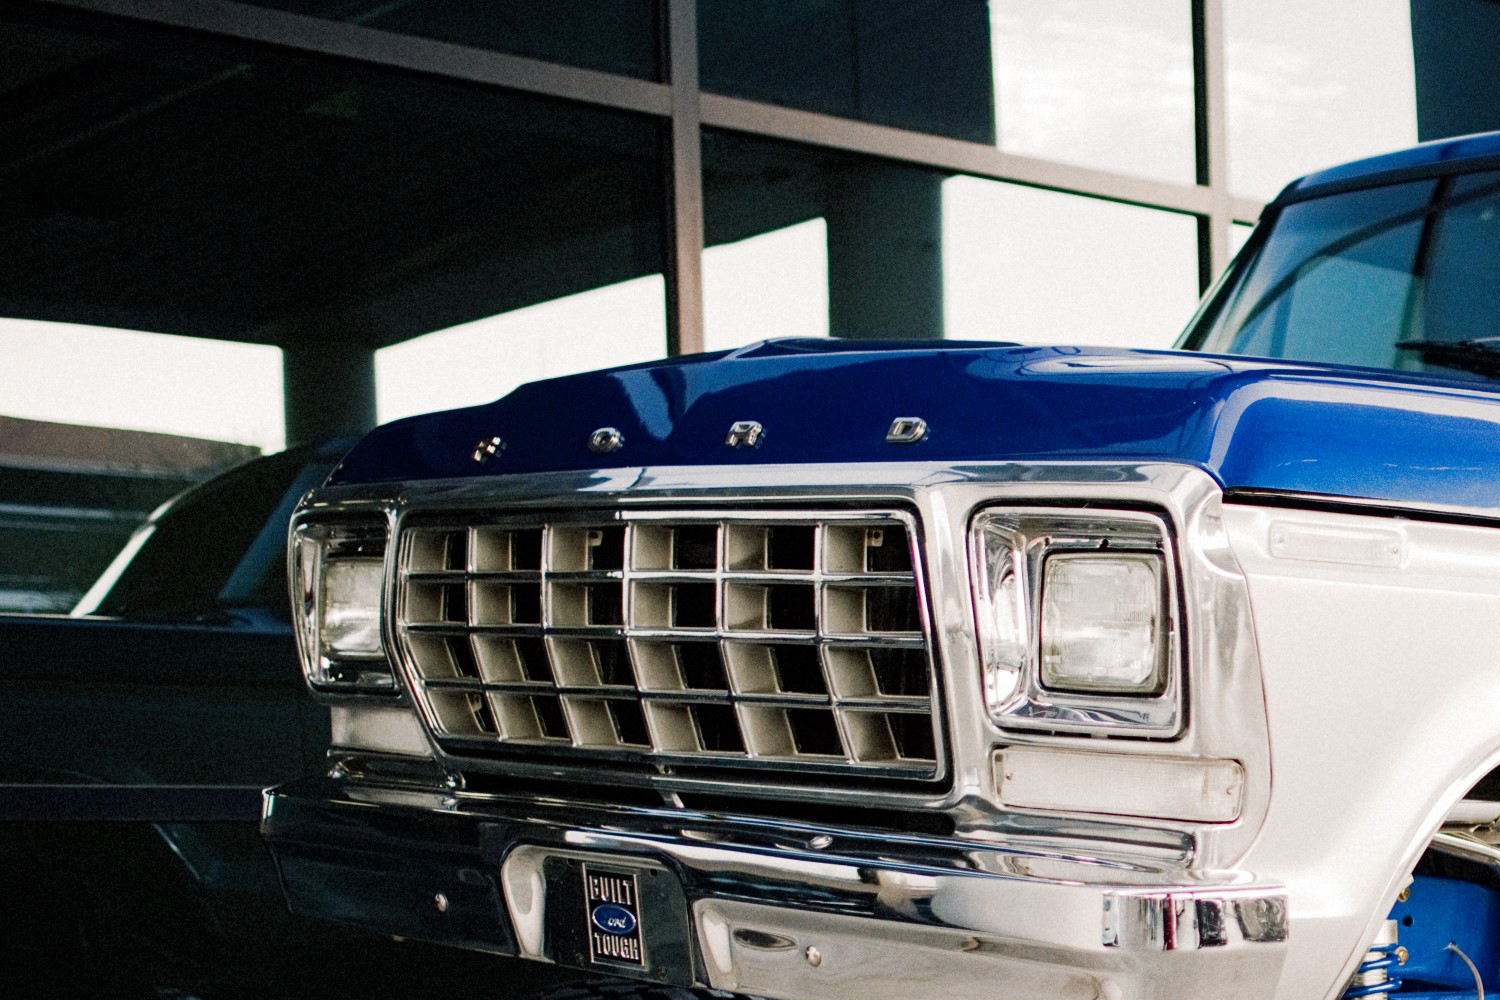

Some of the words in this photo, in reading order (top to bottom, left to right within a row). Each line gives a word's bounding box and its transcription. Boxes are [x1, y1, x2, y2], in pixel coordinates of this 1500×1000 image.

[472, 416, 930, 464] FORD
[589, 874, 633, 905] BUILT
[594, 932, 640, 960] TOUGH
